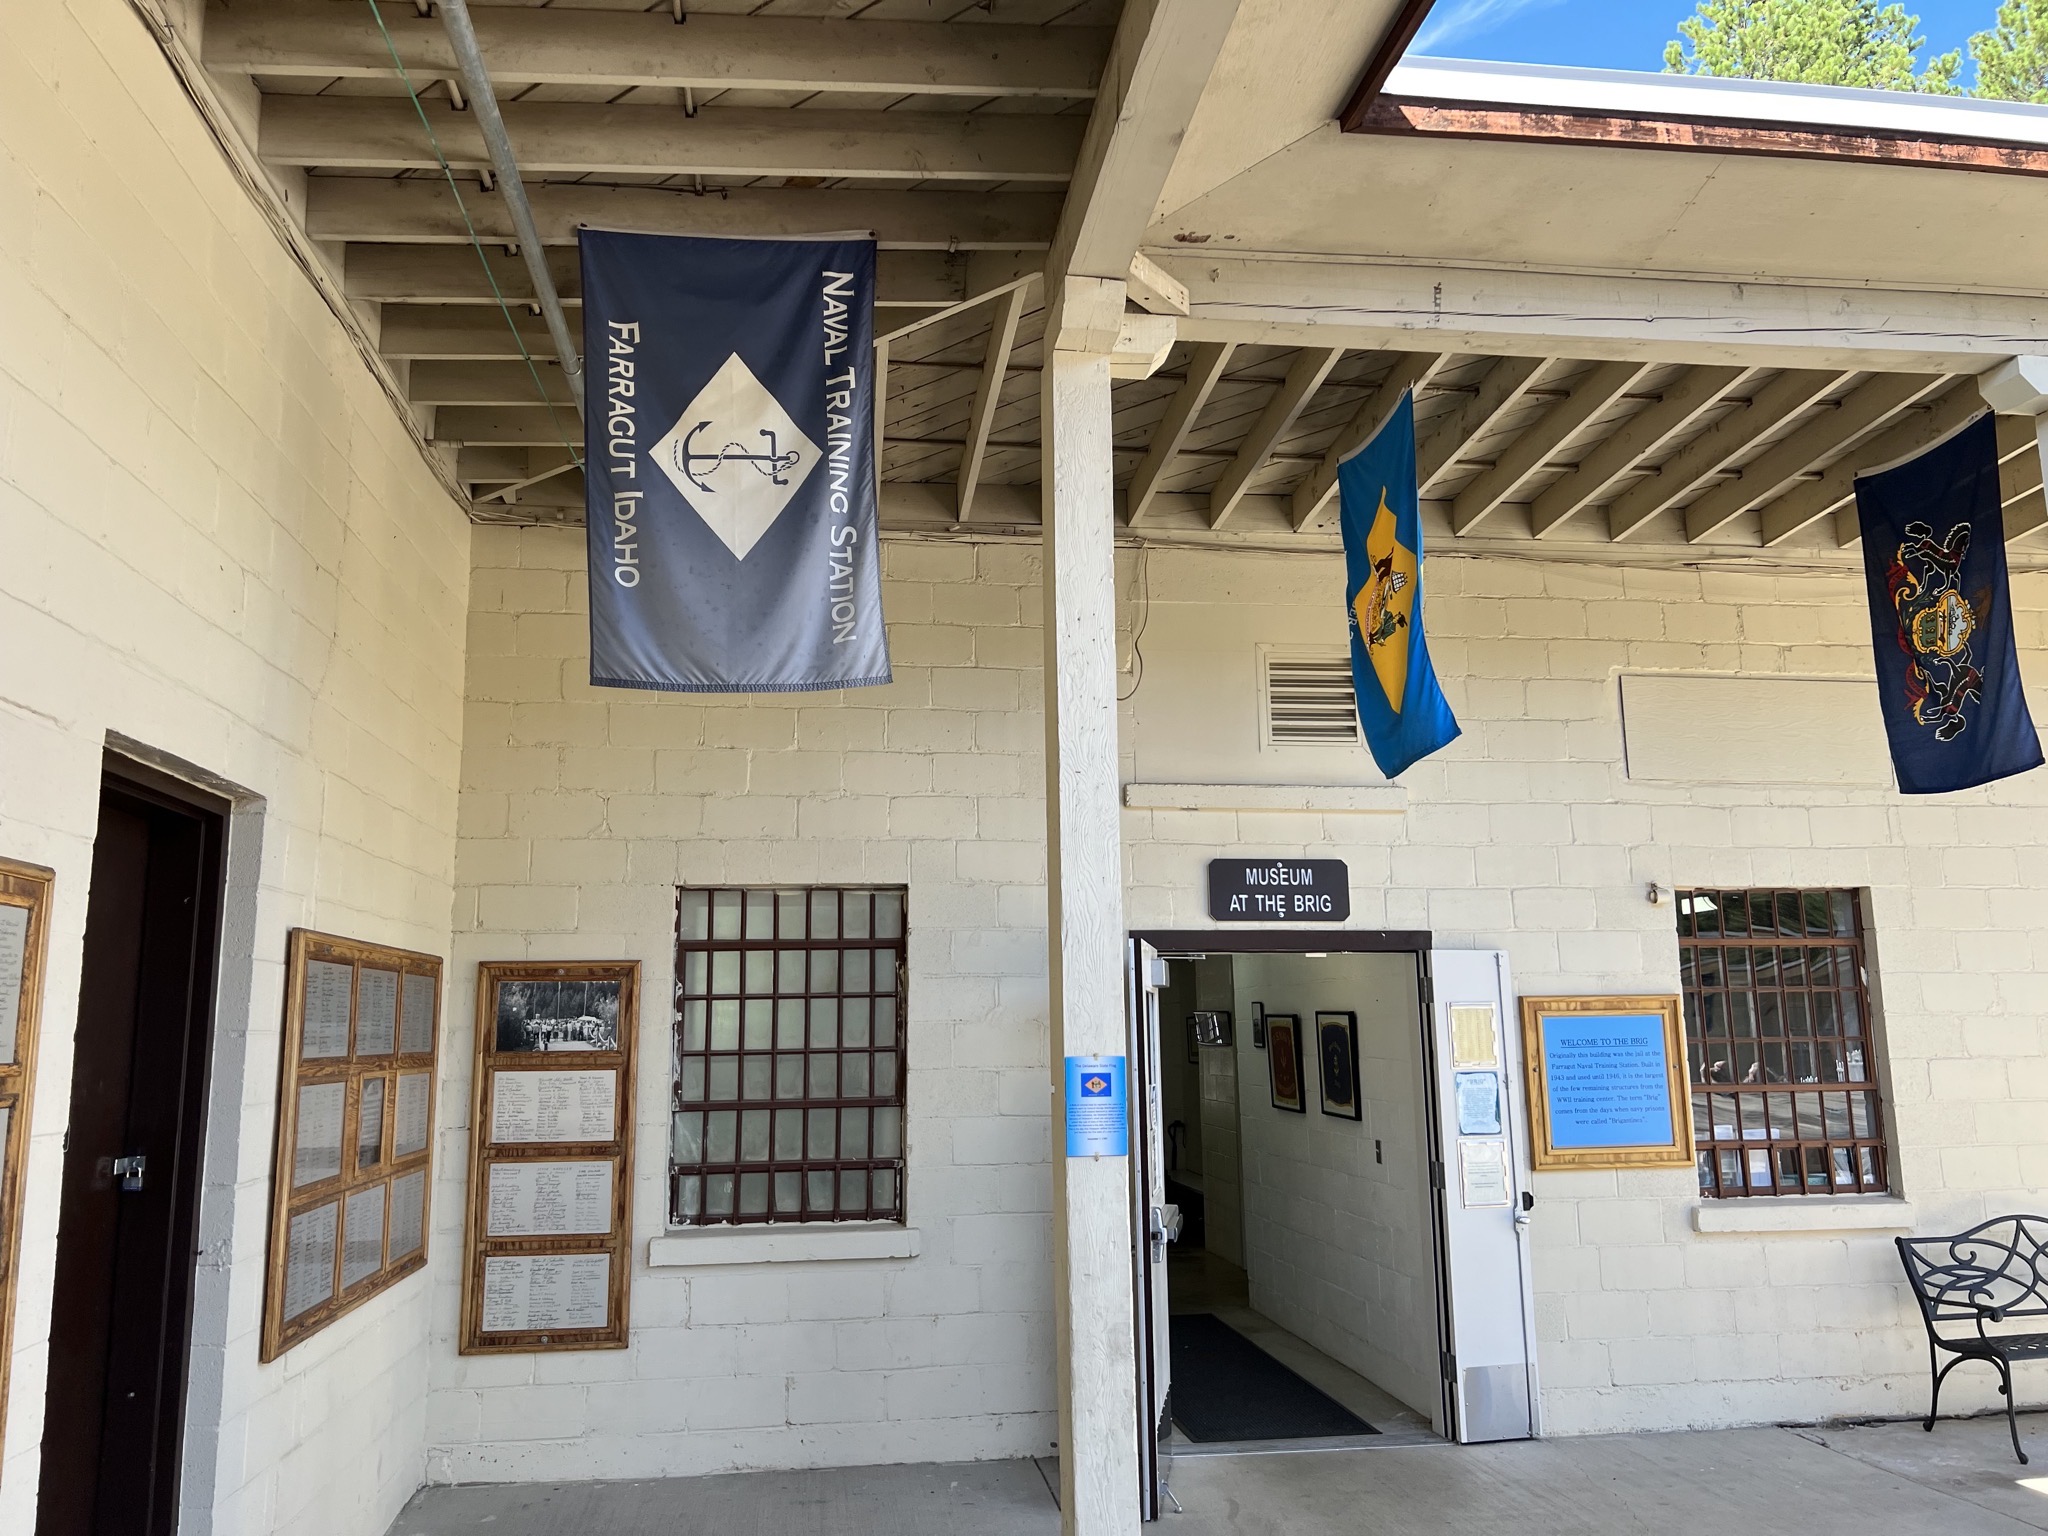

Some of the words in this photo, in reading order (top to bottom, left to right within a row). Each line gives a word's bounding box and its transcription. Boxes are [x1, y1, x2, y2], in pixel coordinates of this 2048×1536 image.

[822, 271, 854, 366] NAVAL
[608, 319, 641, 479] FARRAGUT
[825, 366, 856, 514] TRAINING
[614, 491, 643, 588] IDAHO
[830, 524, 857, 644] STATION
[1230, 895, 1248, 911] AT
[1255, 895, 1286, 911] THE
[1294, 895, 1331, 912] BRIG
[1246, 868, 1312, 885] MUSEUM
